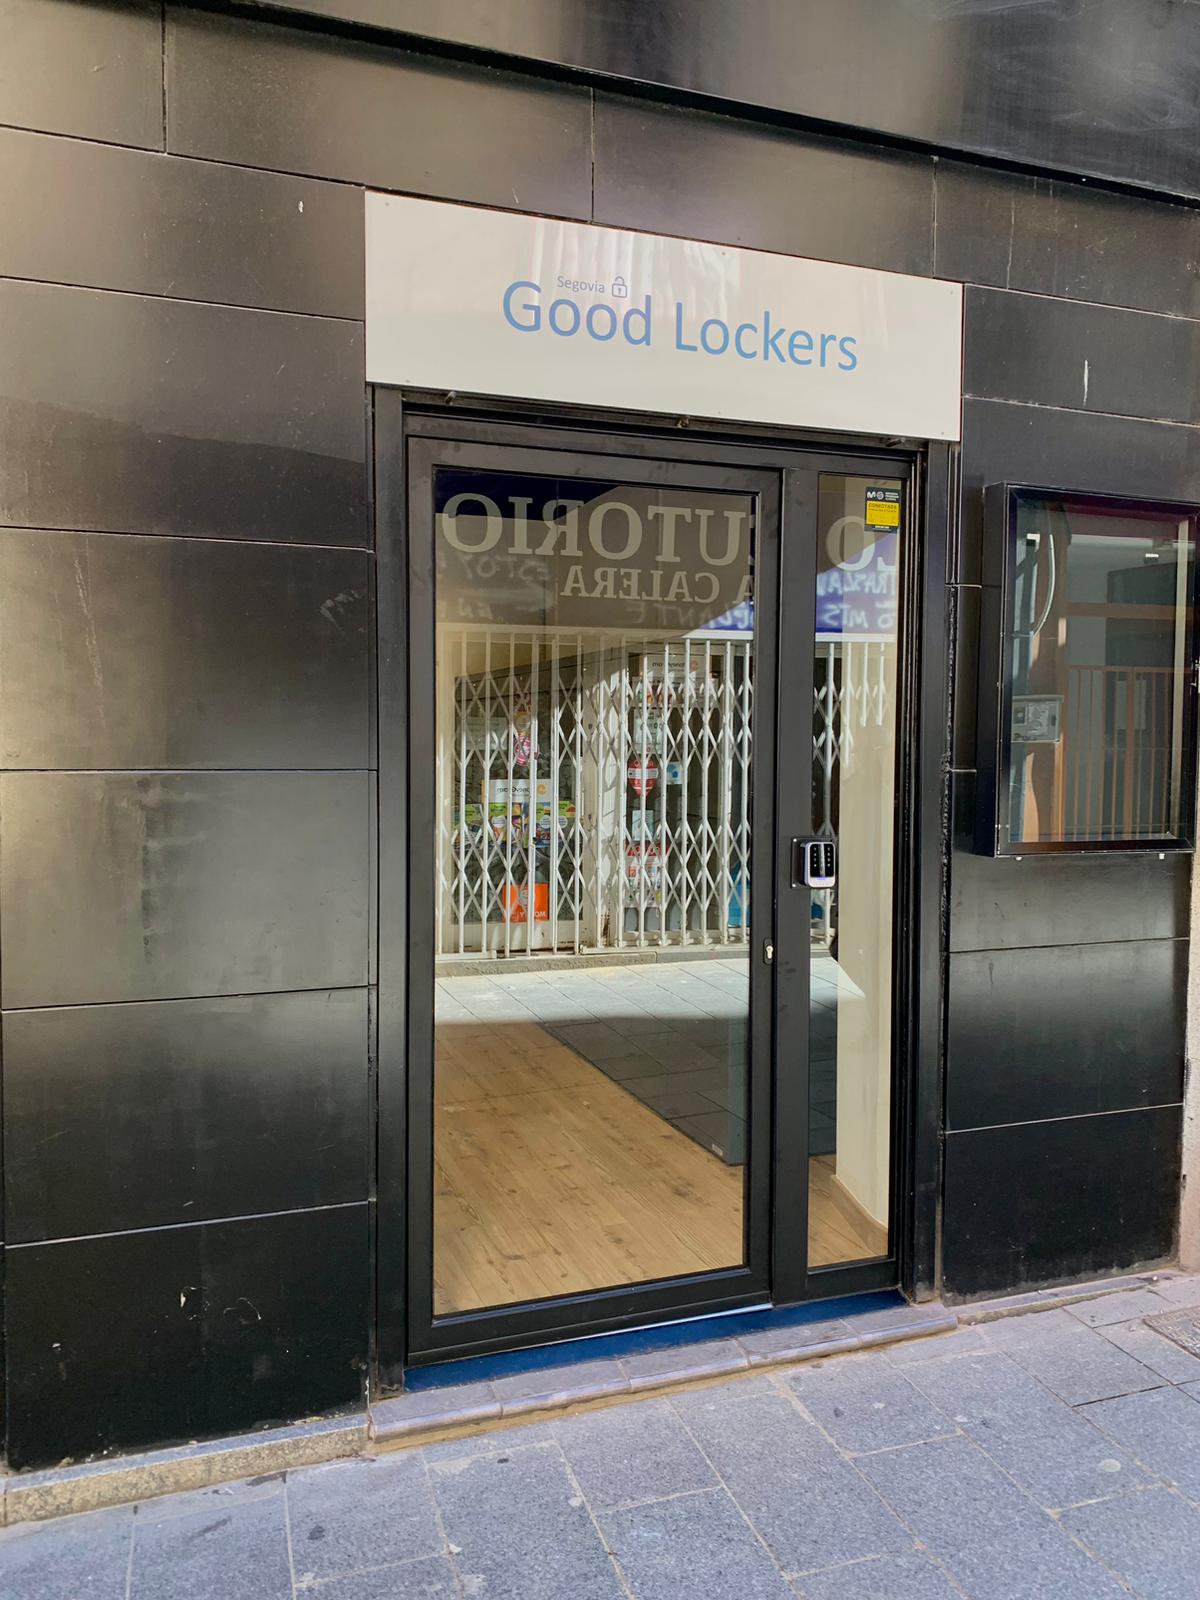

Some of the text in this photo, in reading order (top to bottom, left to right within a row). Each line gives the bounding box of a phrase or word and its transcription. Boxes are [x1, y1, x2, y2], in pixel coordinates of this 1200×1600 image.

[556, 275, 606, 296] Segovia
[503, 281, 858, 371] Good Lockers
